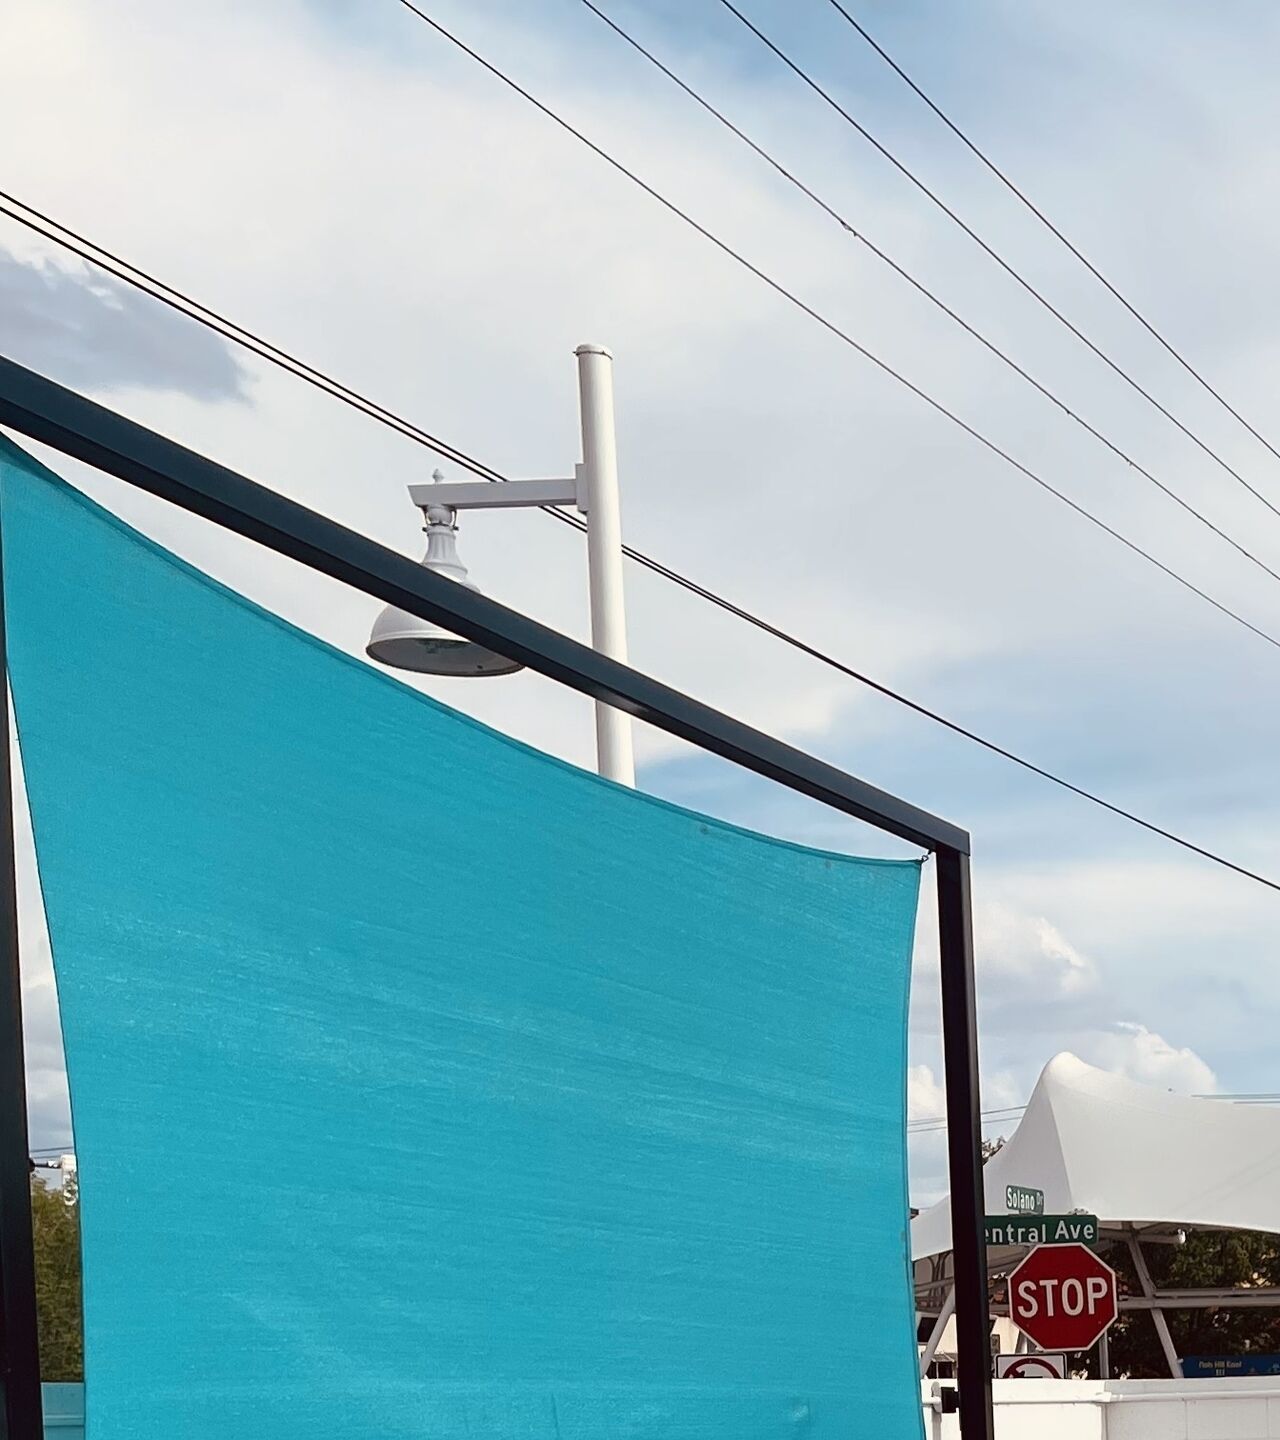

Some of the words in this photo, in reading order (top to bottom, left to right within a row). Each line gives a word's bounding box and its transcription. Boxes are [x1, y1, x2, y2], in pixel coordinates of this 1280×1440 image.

[1007, 1186, 1035, 1211] Solano
[984, 1223, 1047, 1243] ntral
[1054, 1219, 1094, 1240] Ave
[1017, 1276, 1109, 1319] STOP
